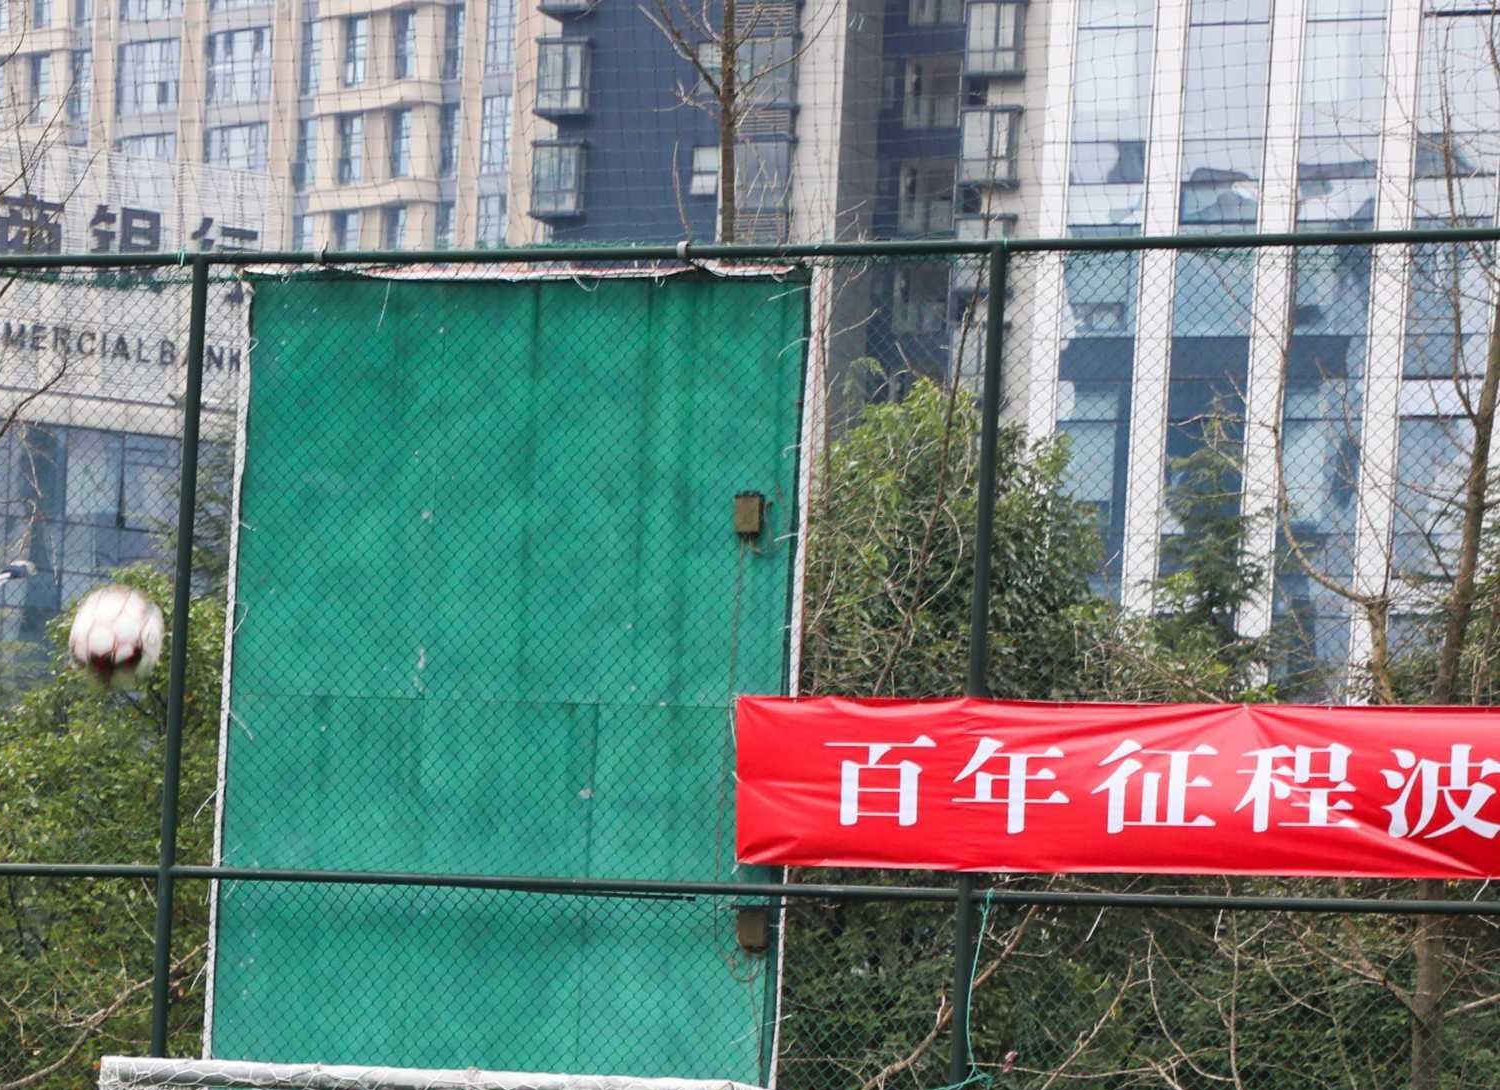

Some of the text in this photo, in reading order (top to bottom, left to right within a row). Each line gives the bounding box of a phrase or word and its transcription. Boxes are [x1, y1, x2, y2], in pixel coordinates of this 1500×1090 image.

[158, 339, 242, 372] BNK
[822, 735, 1500, 840] 百年征程波
